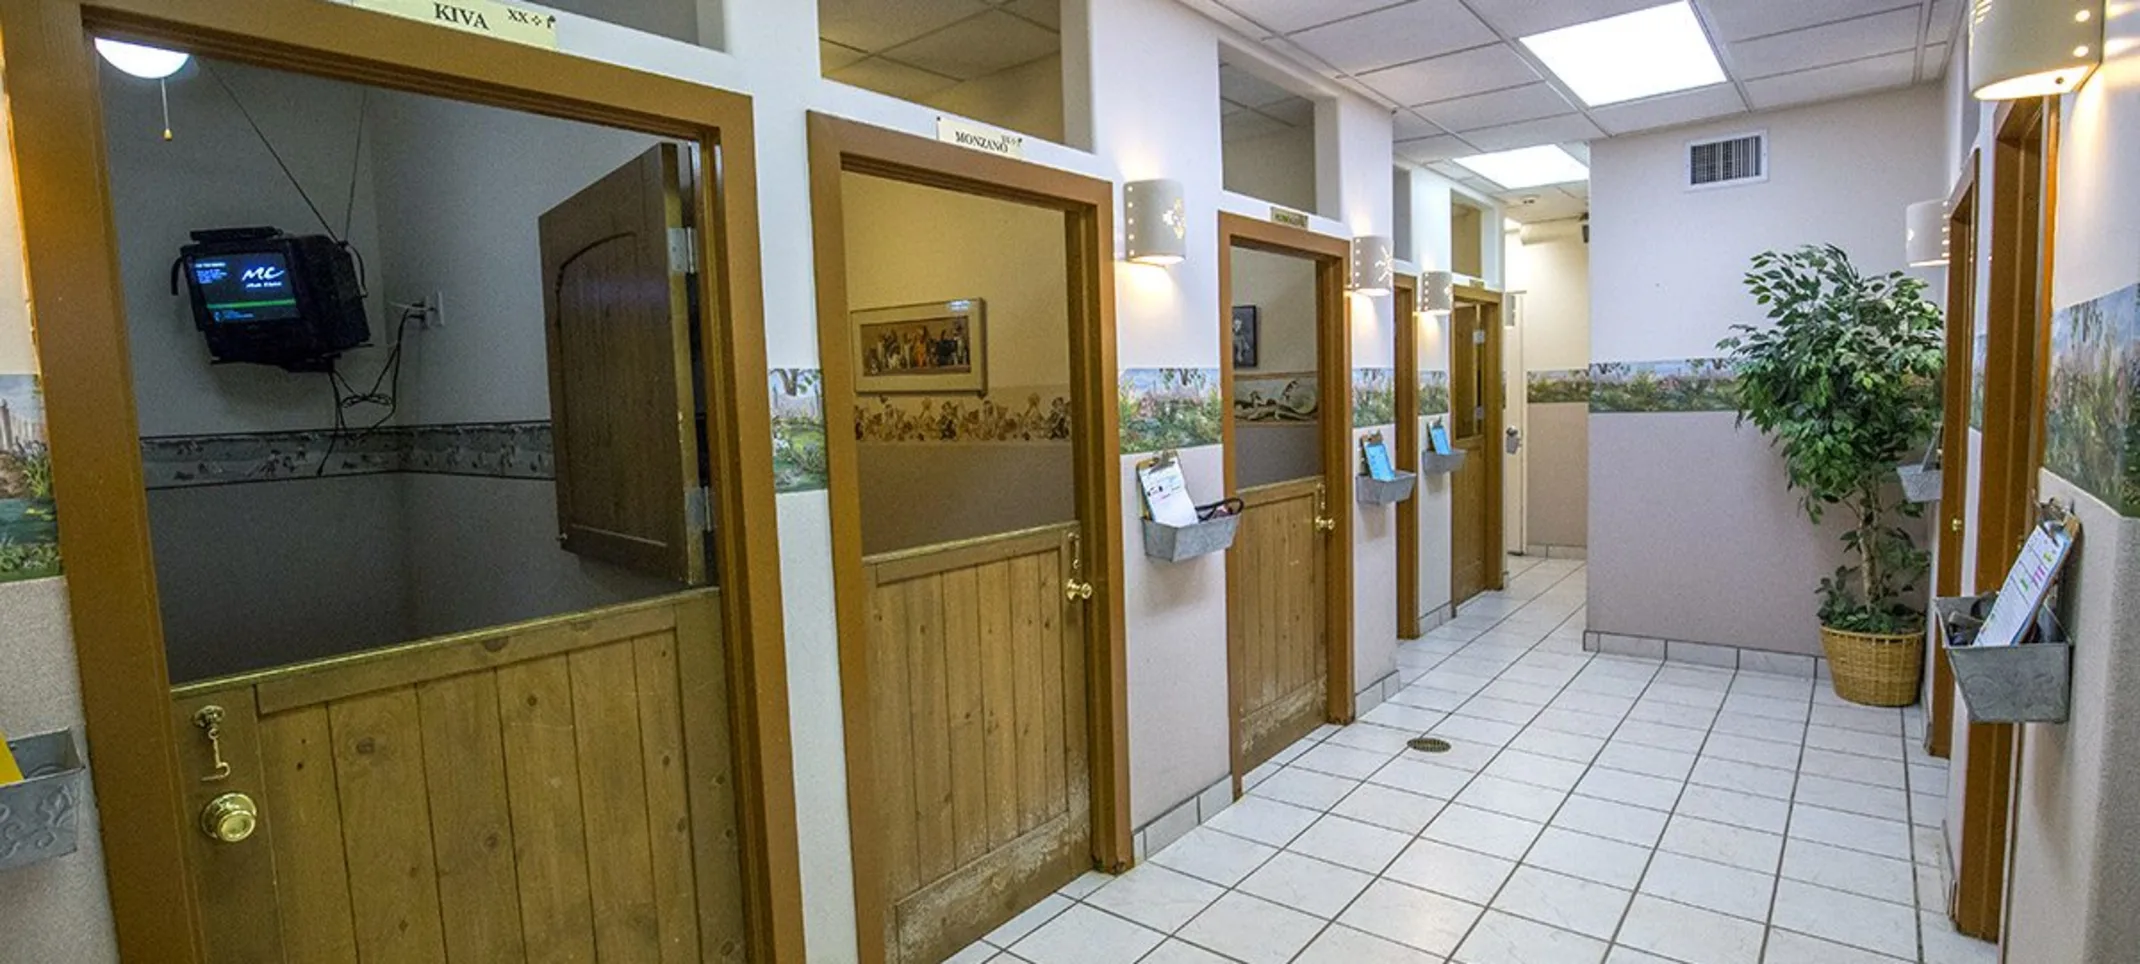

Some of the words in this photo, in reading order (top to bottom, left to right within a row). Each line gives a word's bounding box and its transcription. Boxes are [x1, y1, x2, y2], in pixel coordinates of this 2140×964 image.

[434, 3, 490, 30] KIVA
[955, 131, 1009, 153] MONZANO
[241, 266, 285, 281] MC
